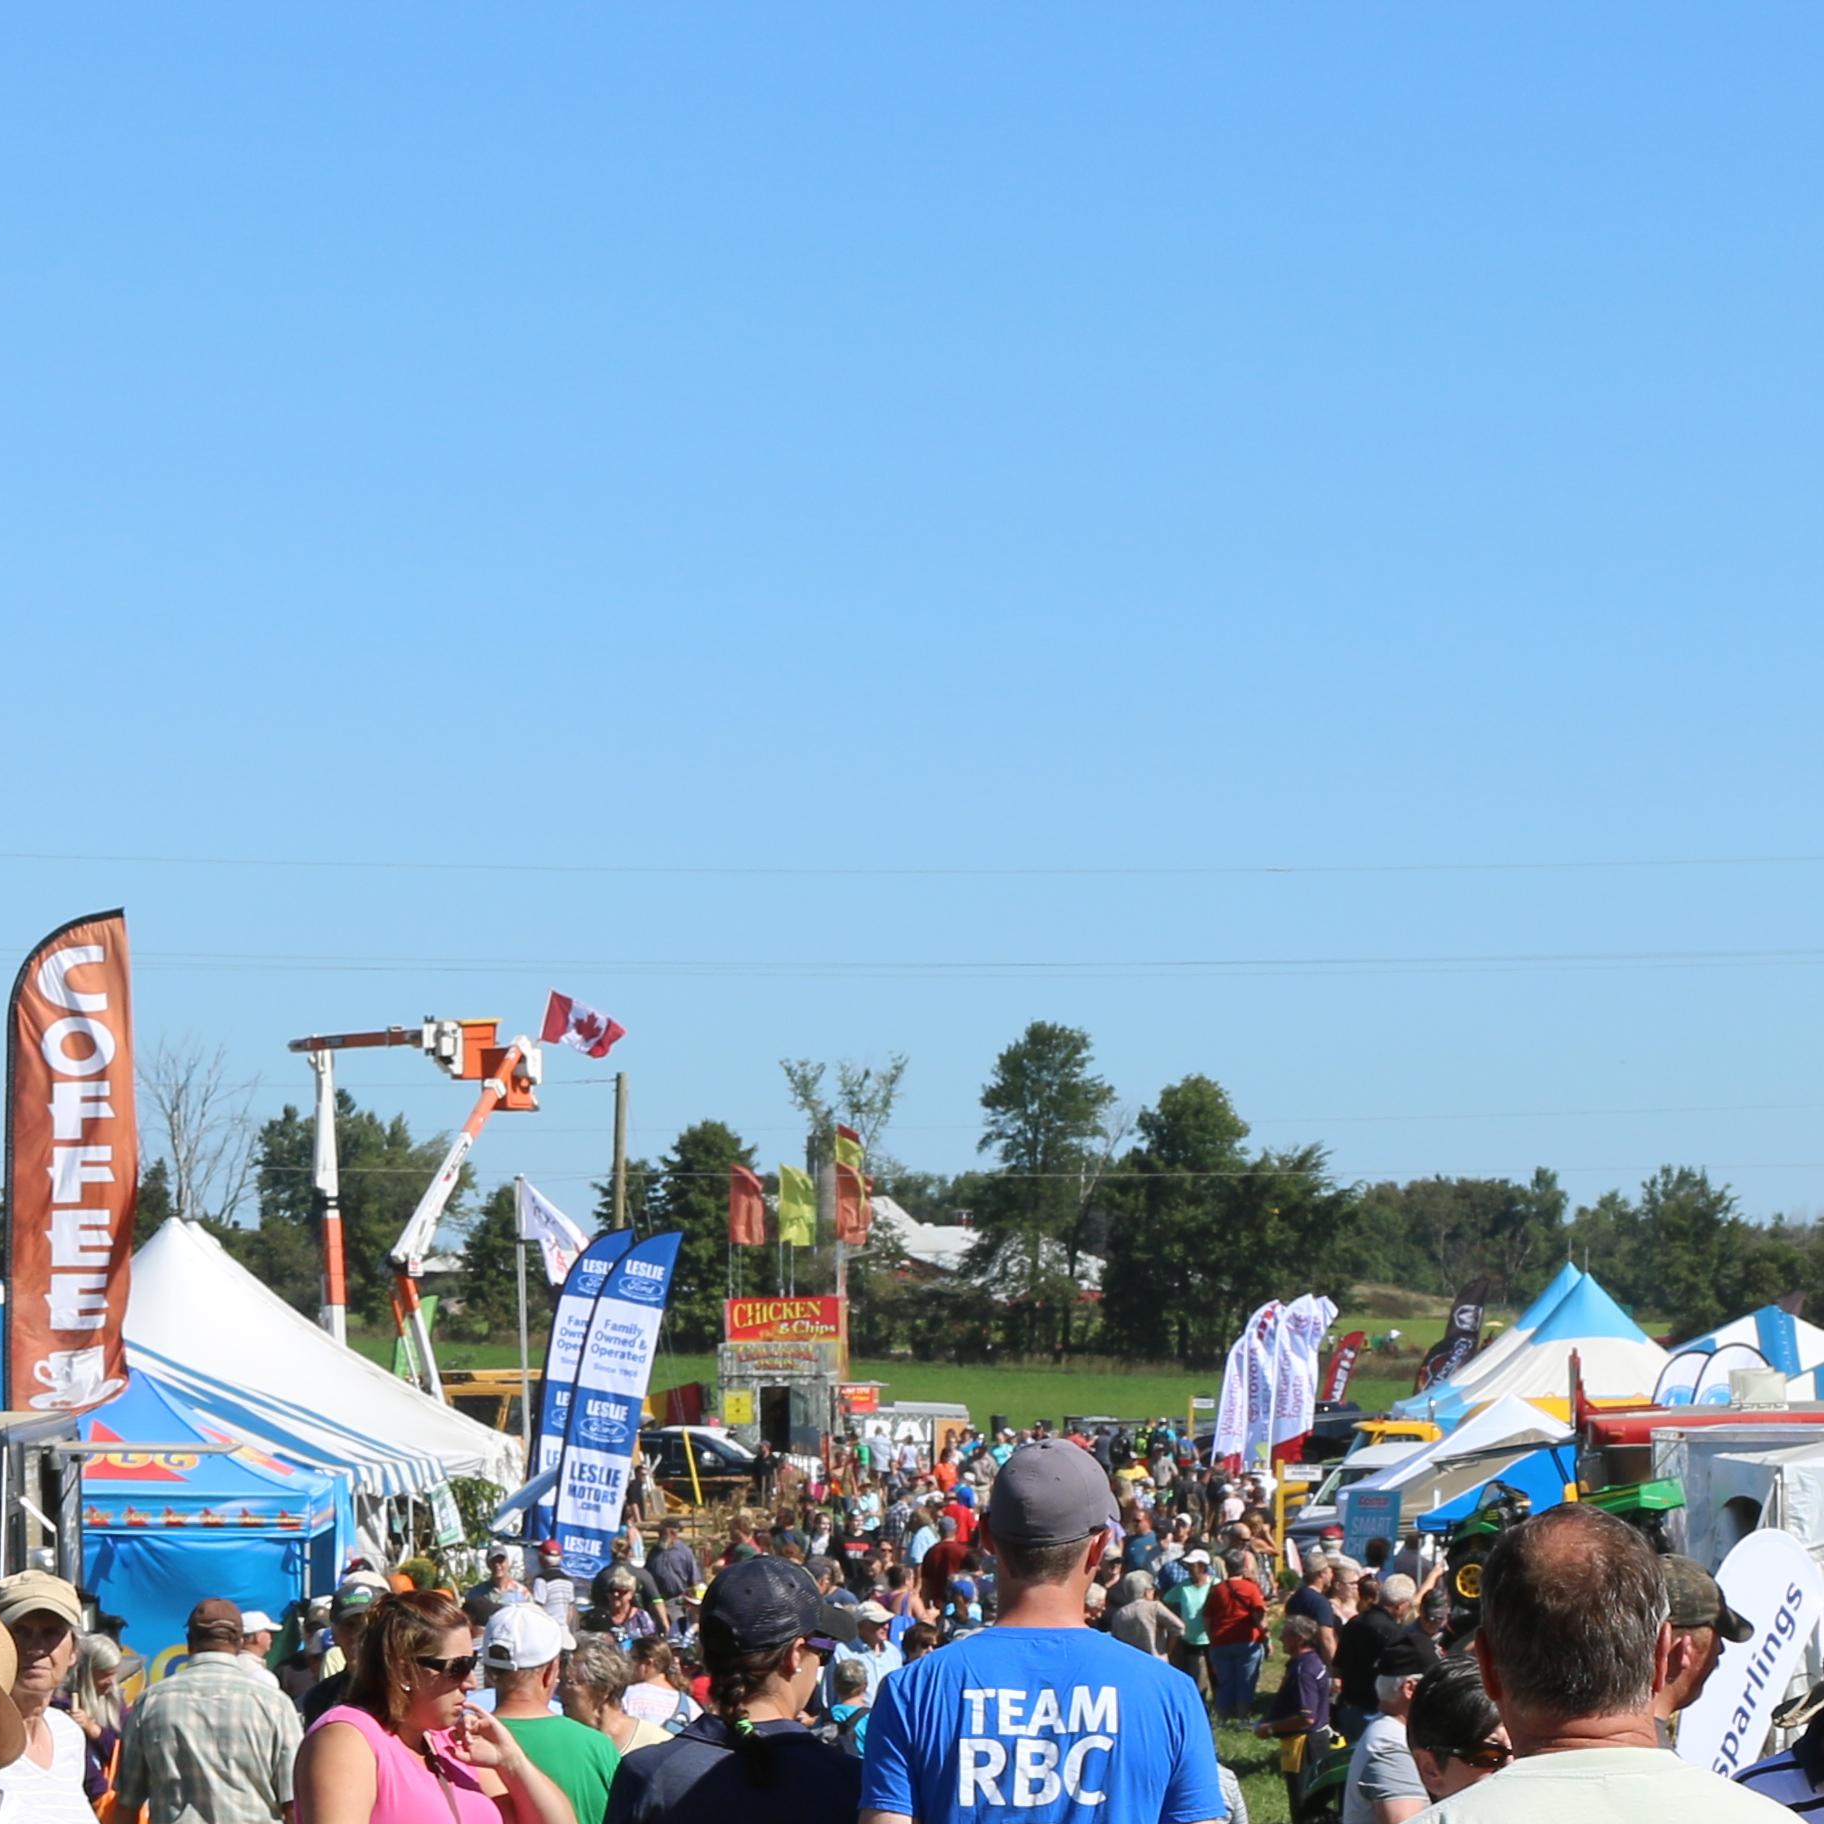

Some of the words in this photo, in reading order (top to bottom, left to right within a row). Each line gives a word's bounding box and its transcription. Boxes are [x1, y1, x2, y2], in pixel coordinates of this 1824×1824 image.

[38, 944, 116, 1330] COFFEE
[625, 1259, 665, 1281] LESLIE
[733, 1301, 822, 1329] CHICKEN
[604, 1319, 645, 1340] Family
[778, 1321, 789, 1334] &
[792, 1319, 836, 1334] Chips
[594, 1331, 636, 1348] Owned
[638, 1339, 647, 1350] &
[591, 1344, 646, 1364] Operated
[586, 1399, 629, 1421] LESLIE
[569, 1461, 622, 1487] LESLIE
[567, 1484, 617, 1505] MOTORS
[1352, 1517, 1392, 1535] SMART
[564, 1535, 603, 1556] LESLIE
[1716, 1580, 1804, 1781] sparlings
[963, 1685, 1118, 1736] TEAM
[959, 1735, 1115, 1807] RBC
